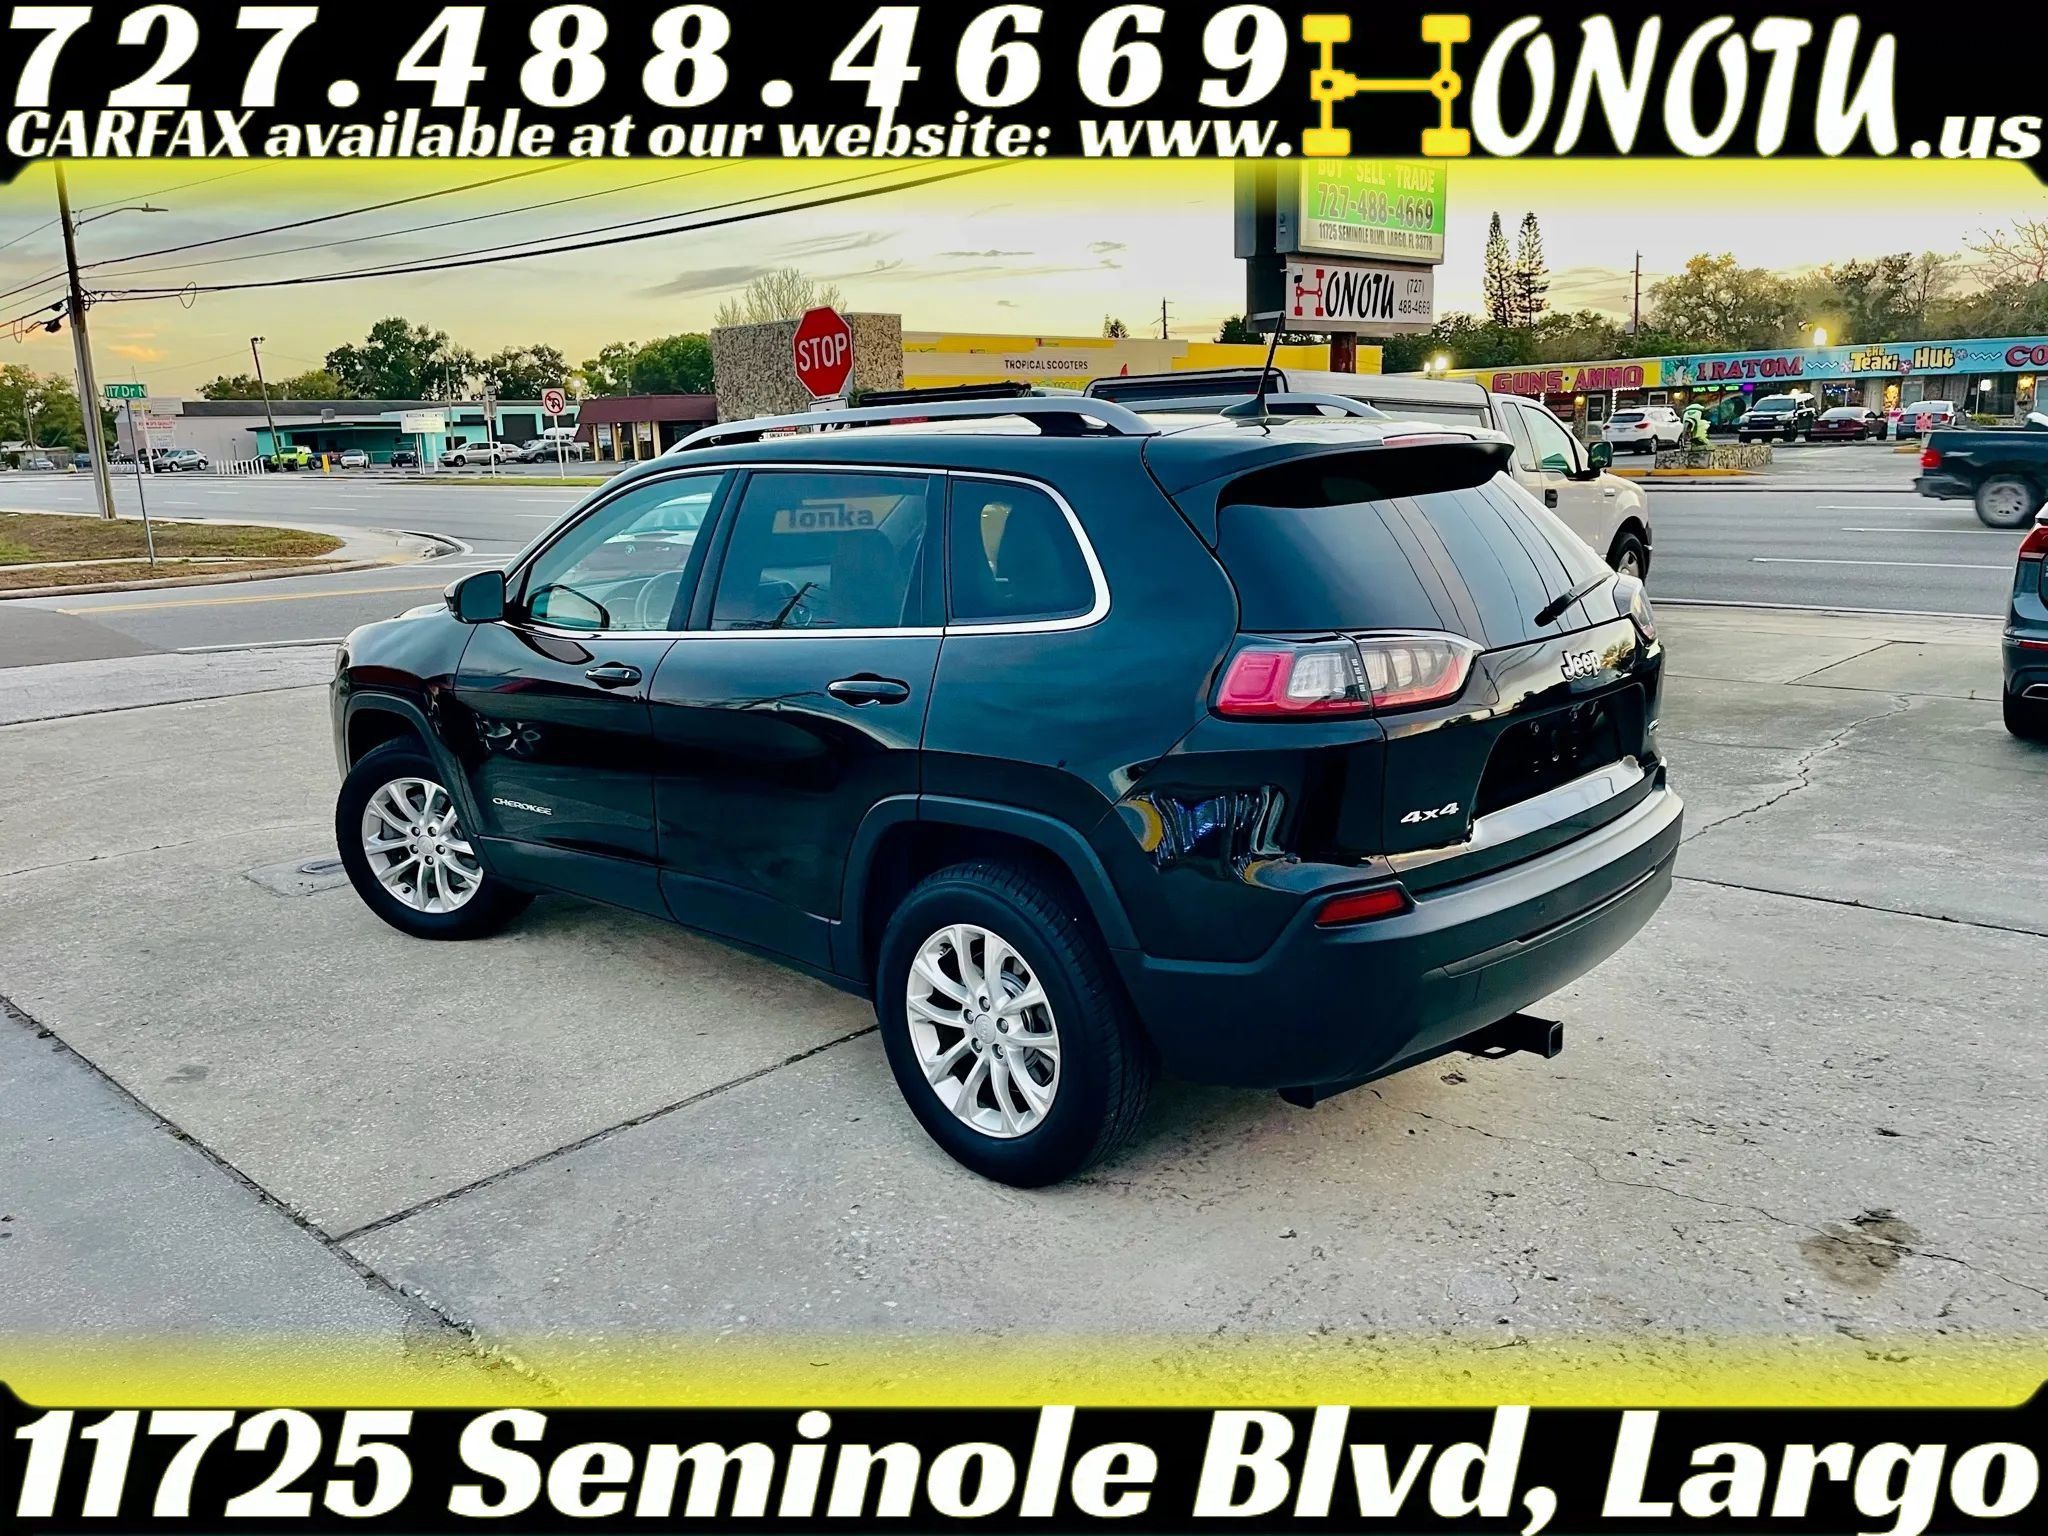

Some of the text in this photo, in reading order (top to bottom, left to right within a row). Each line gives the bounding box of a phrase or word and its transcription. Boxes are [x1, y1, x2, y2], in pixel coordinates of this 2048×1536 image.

[1356, 161, 1385, 186] SELL
[1396, 165, 1435, 194] TRADE
[1318, 181, 1434, 231] 727-488-4669
[1319, 223, 1337, 240] 11725
[1338, 225, 1368, 244] SEMINOLE
[1408, 234, 1415, 249] FL
[1406, 279, 1425, 296] (727)
[1398, 300, 1430, 315] 488-4669
[798, 333, 848, 372] STOP
[1914, 346, 1955, 369] Hut
[2005, 345, 2048, 367] CO
[1004, 359, 1089, 370] TROPICAL SCOOTERS
[1492, 365, 1644, 394] GUNS AMMO
[106, 386, 146, 397] 117 Dr N
[1562, 651, 1600, 681] Jeep
[492, 797, 552, 816] CHEROKEE
[1400, 803, 1459, 824] 4x4
